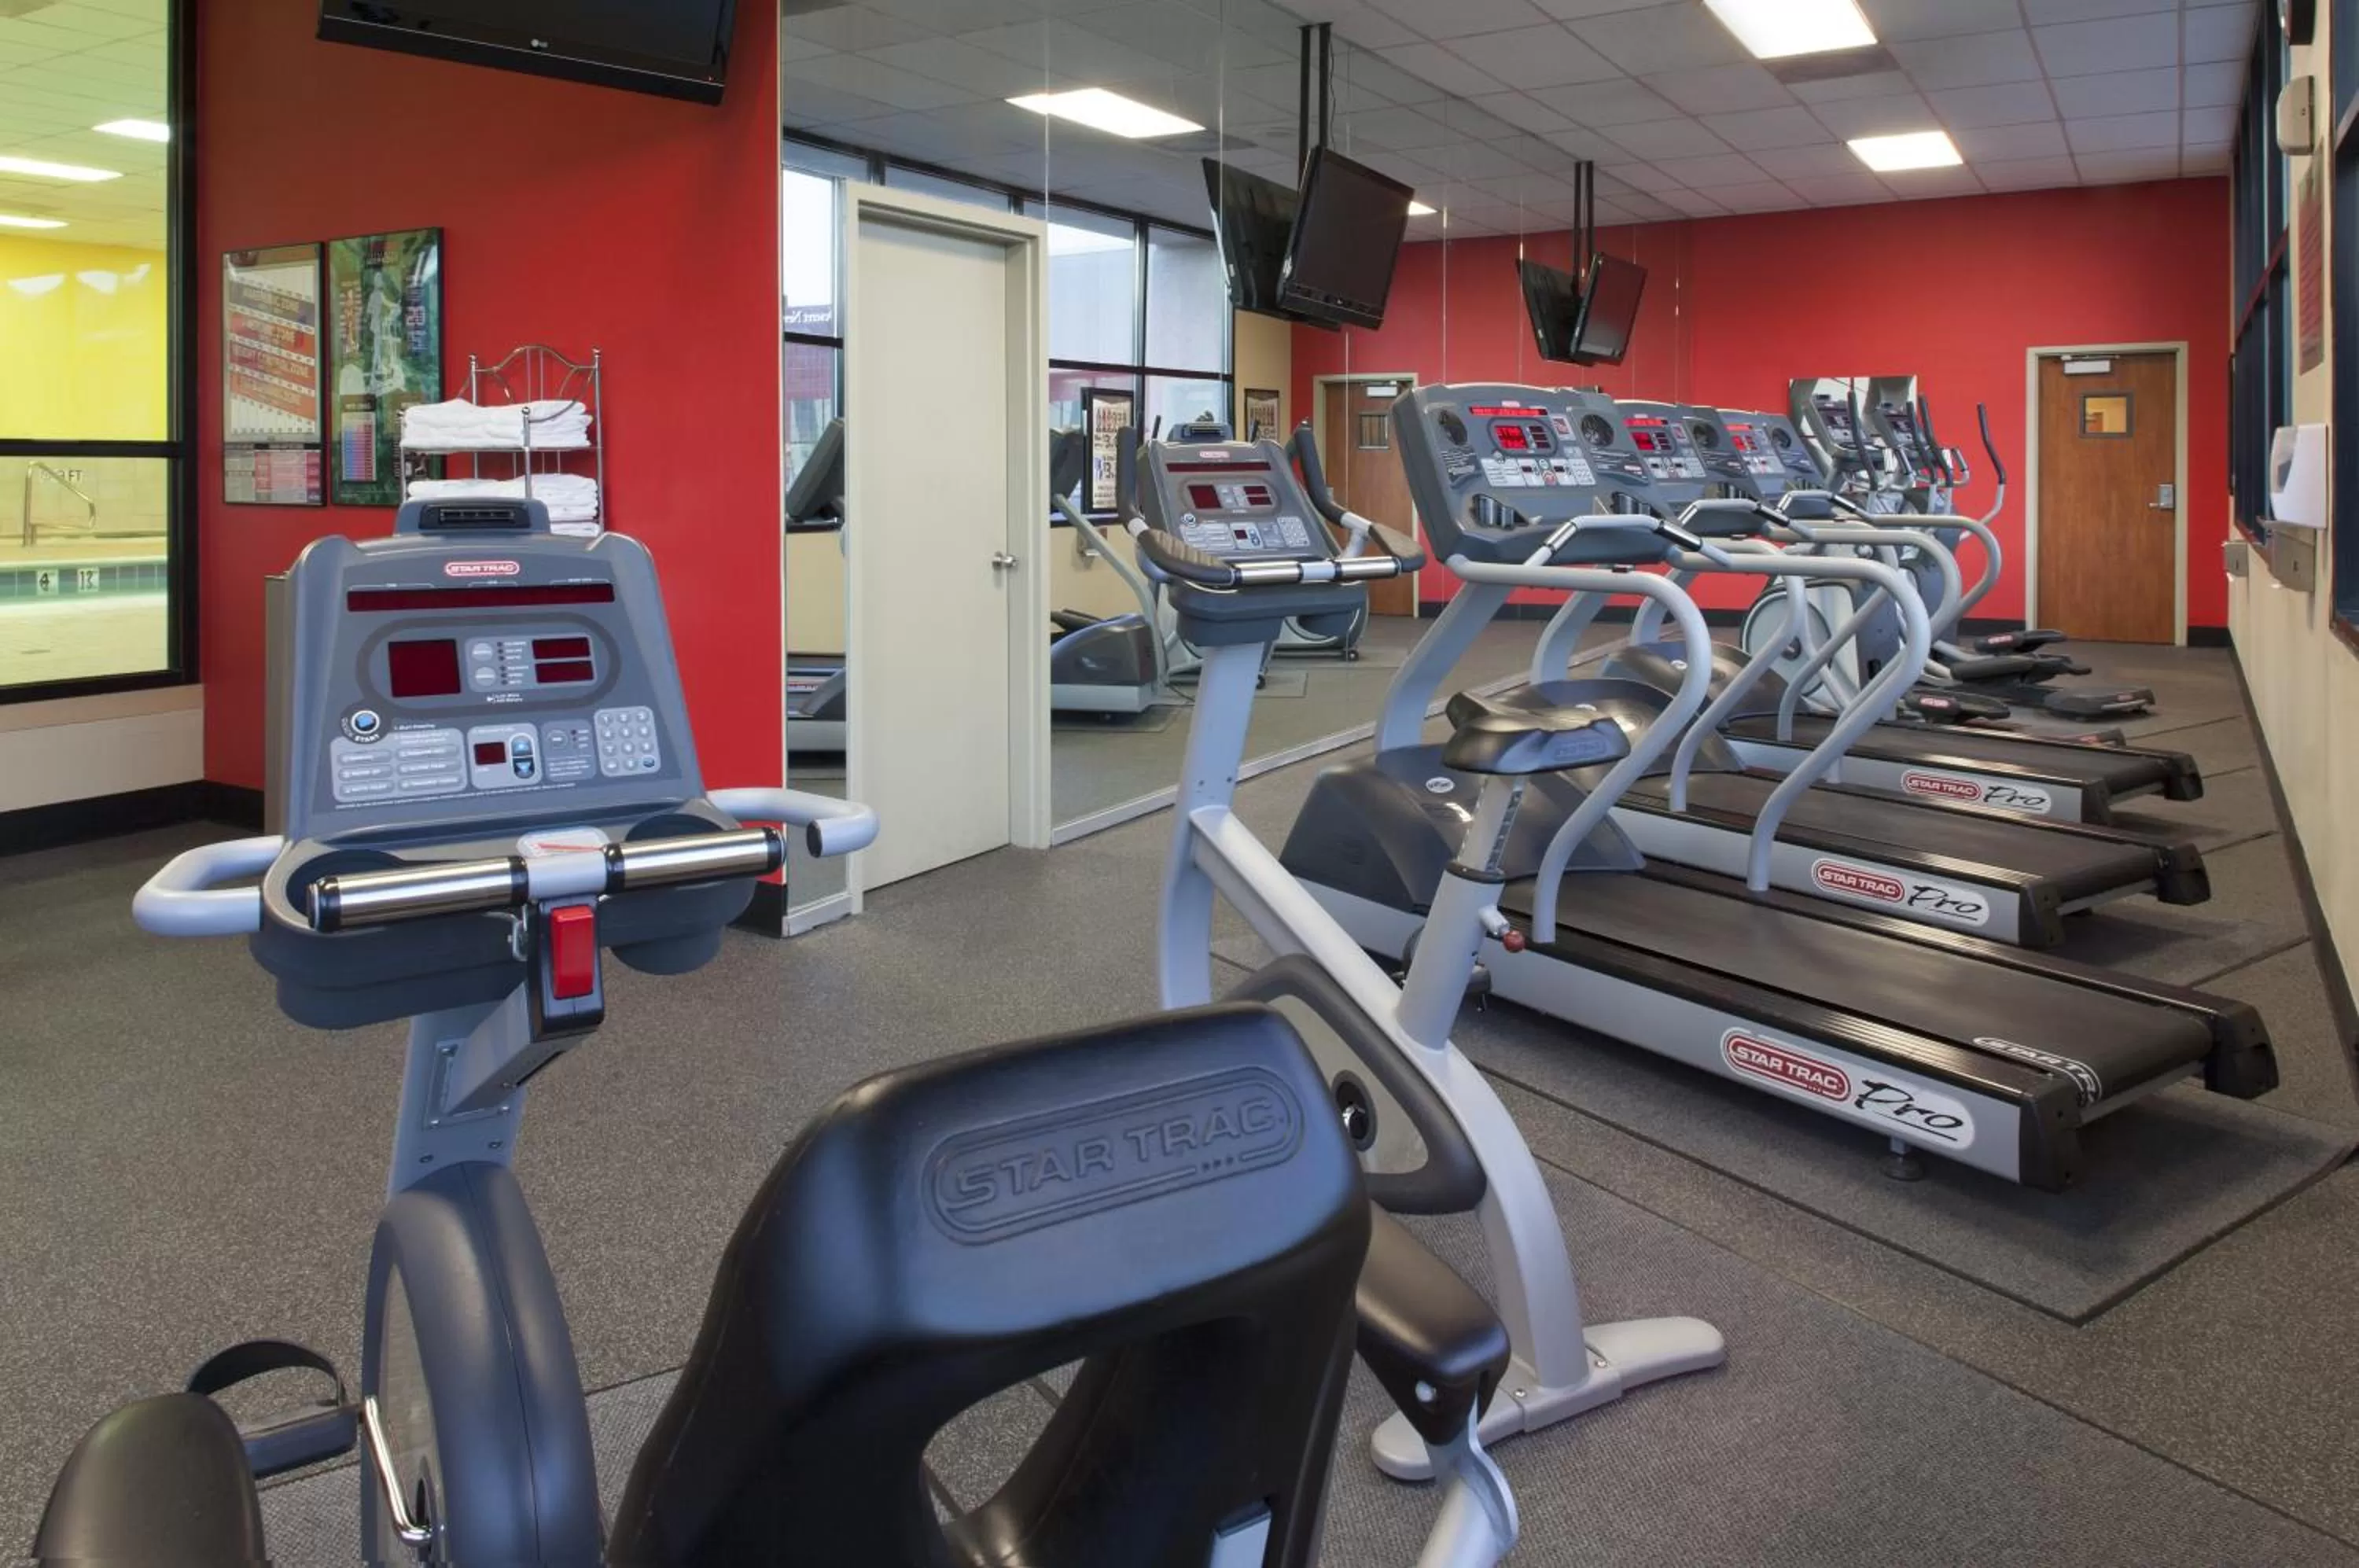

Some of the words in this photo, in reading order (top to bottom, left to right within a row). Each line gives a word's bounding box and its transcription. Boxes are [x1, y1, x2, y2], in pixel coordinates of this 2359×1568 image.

[1911, 779, 1940, 791] STAR
[1942, 783, 1975, 796] TRAC
[1983, 786, 2047, 806] Pro
[1822, 870, 1857, 886] STAR
[1859, 878, 1897, 896] TRAC
[1908, 885, 1982, 914] Pro
[1731, 1046, 1783, 1072] STAR
[1786, 1062, 1839, 1091] TRAC
[1853, 1078, 1963, 1128] Pro
[946, 1138, 1115, 1212] STAR
[1124, 1097, 1277, 1163] TRAC
